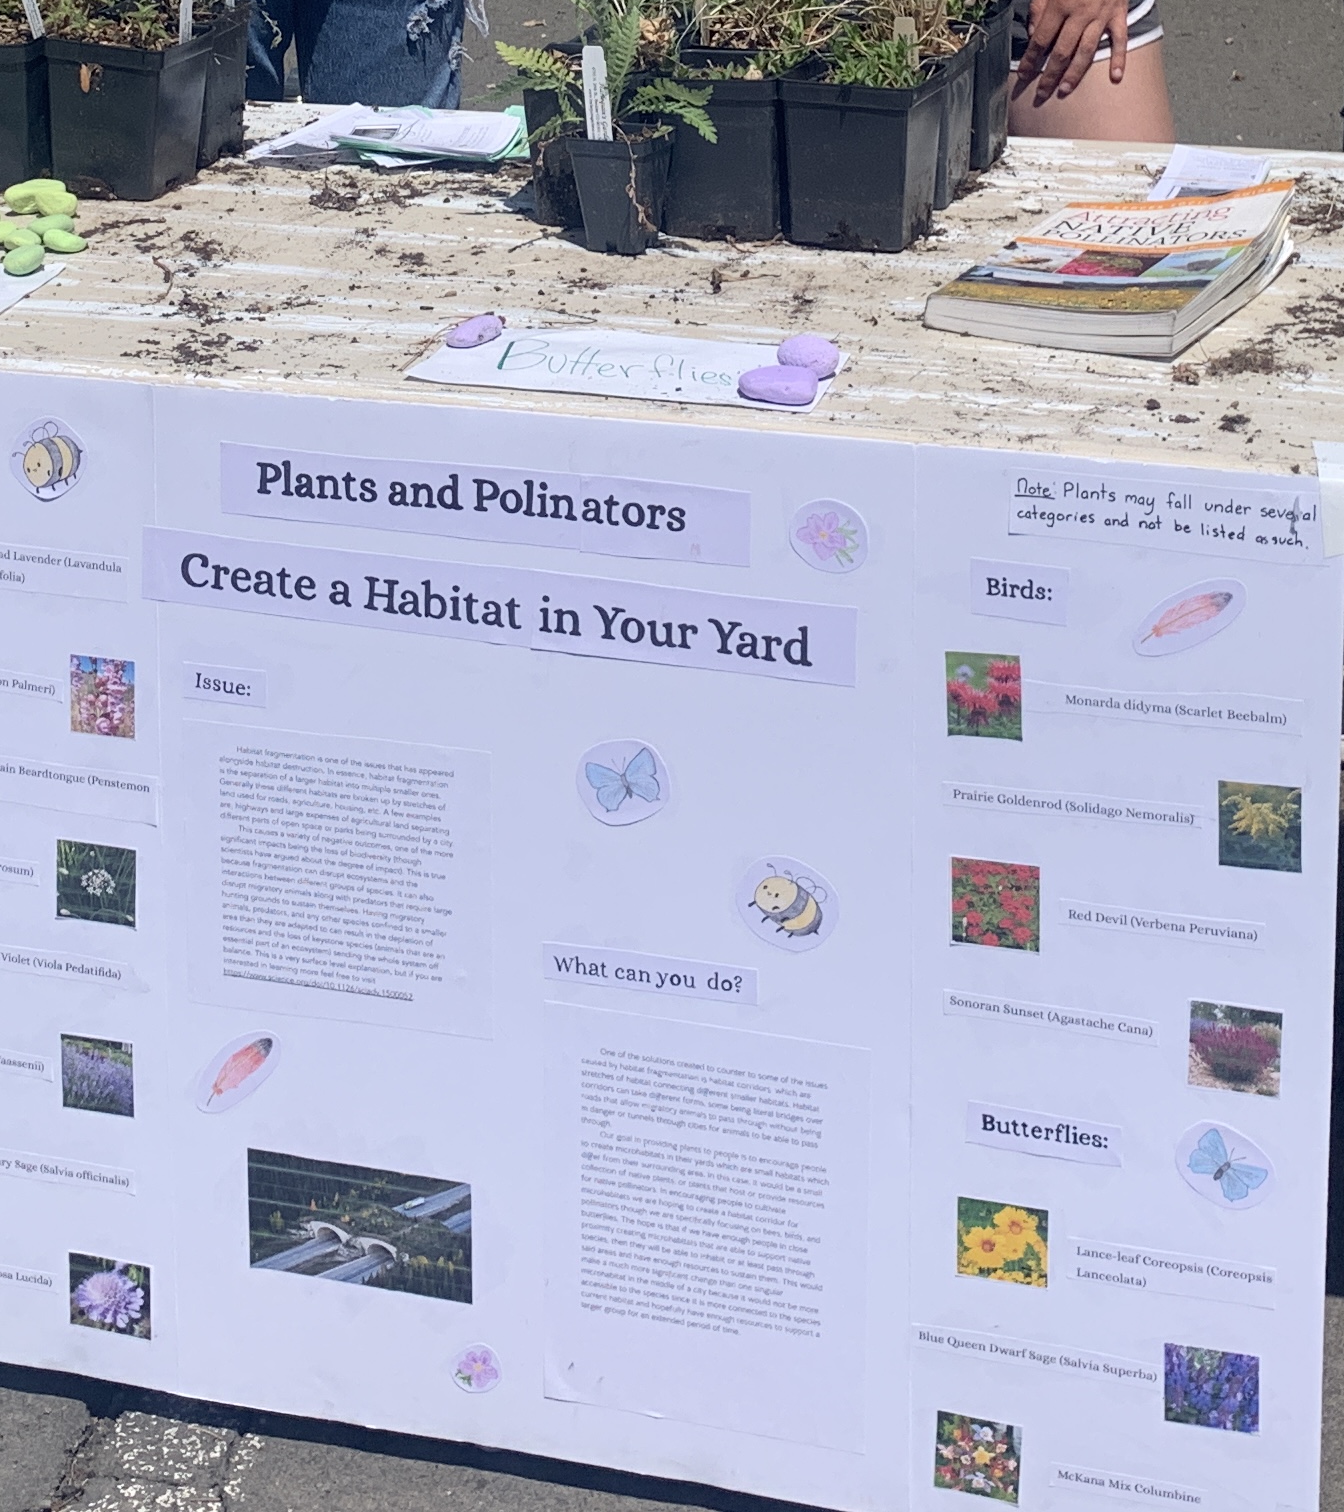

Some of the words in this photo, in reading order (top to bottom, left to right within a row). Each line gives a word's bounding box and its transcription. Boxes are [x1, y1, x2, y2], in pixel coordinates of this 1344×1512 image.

[1054, 220, 1196, 236] NATIVE
[1068, 206, 1233, 226] Attracting
[1041, 229, 1247, 247] POLLINATORS
[497, 338, 733, 387] Butterflies
[255, 459, 378, 503] Plants
[387, 472, 464, 511] and
[471, 477, 686, 533] Polinators
[1062, 480, 1116, 503] Plants
[1124, 493, 1156, 516] may
[1165, 490, 1192, 510] fall
[1203, 497, 1252, 516] under
[1016, 503, 1096, 528] categories
[1103, 511, 1129, 528] and
[1138, 518, 1162, 530] not
[1173, 518, 1191, 534] be
[1200, 522, 1245, 541] listed
[12, 550, 62, 566] Lavender
[62, 555, 122, 574] (Lavandula
[985, 576, 1052, 601] Birds:
[180, 552, 317, 601] Create
[328, 579, 352, 608] a
[362, 575, 522, 630] Habitat
[538, 594, 582, 637] in
[592, 604, 699, 650] Your
[706, 617, 814, 668] Yard
[11, 678, 56, 697] Palmeri)
[194, 671, 251, 697] Issue:
[1065, 693, 1121, 709] Monarda
[1122, 698, 1172, 715] didyma
[1174, 703, 1223, 719] (Scarlet
[1226, 708, 1287, 726] Beebalm)
[18, 764, 86, 784] Beardtongue
[86, 774, 150, 793] (Penstemon
[952, 788, 994, 803] Prairie
[996, 793, 1063, 811] Goldenrod
[1064, 799, 1123, 819] (Solidago
[1125, 806, 1196, 826] Nemoralis)
[1067, 908, 1092, 922] Red
[1094, 911, 1128, 926] Devil
[1129, 915, 1186, 933] (Verbena
[1188, 922, 1258, 942] Peruviana)
[0, 951, 31, 966] Violet
[32, 956, 63, 971] (Viola
[64, 961, 122, 981] Pedatifida)
[552, 955, 608, 979] What
[614, 966, 652, 984] can
[654, 970, 696, 989] you
[706, 970, 743, 994] do?
[948, 994, 1001, 1014] Sonoran
[1002, 1003, 1044, 1020] Sunset
[1046, 1010, 1115, 1031] (Agastache
[1116, 1021, 1153, 1038] Cana)
[980, 1112, 1108, 1149] Butterflies:
[14, 1158, 38, 1173] Sage
[38, 1162, 74, 1178] (Salvia
[74, 1169, 130, 1188] officinalis)
[15, 1271, 53, 1288] Lucida)
[1076, 1245, 1142, 1265] Lance-leaf
[1141, 1255, 1204, 1274] Coreopsis
[1205, 1263, 1273, 1284] (Coreopsis
[1076, 1266, 1147, 1288] Lanceolata)
[918, 1330, 945, 1344] Blue
[946, 1335, 986, 1352] Queen
[988, 1342, 1028, 1359] Dwarf
[1028, 1349, 1057, 1366] Sage
[1058, 1354, 1100, 1372] (Salvia
[1102, 1362, 1158, 1383] Superba)
[1057, 1469, 1105, 1487] McKana
[1107, 1478, 1131, 1492] Mix
[1133, 1482, 1201, 1504] Columbine
